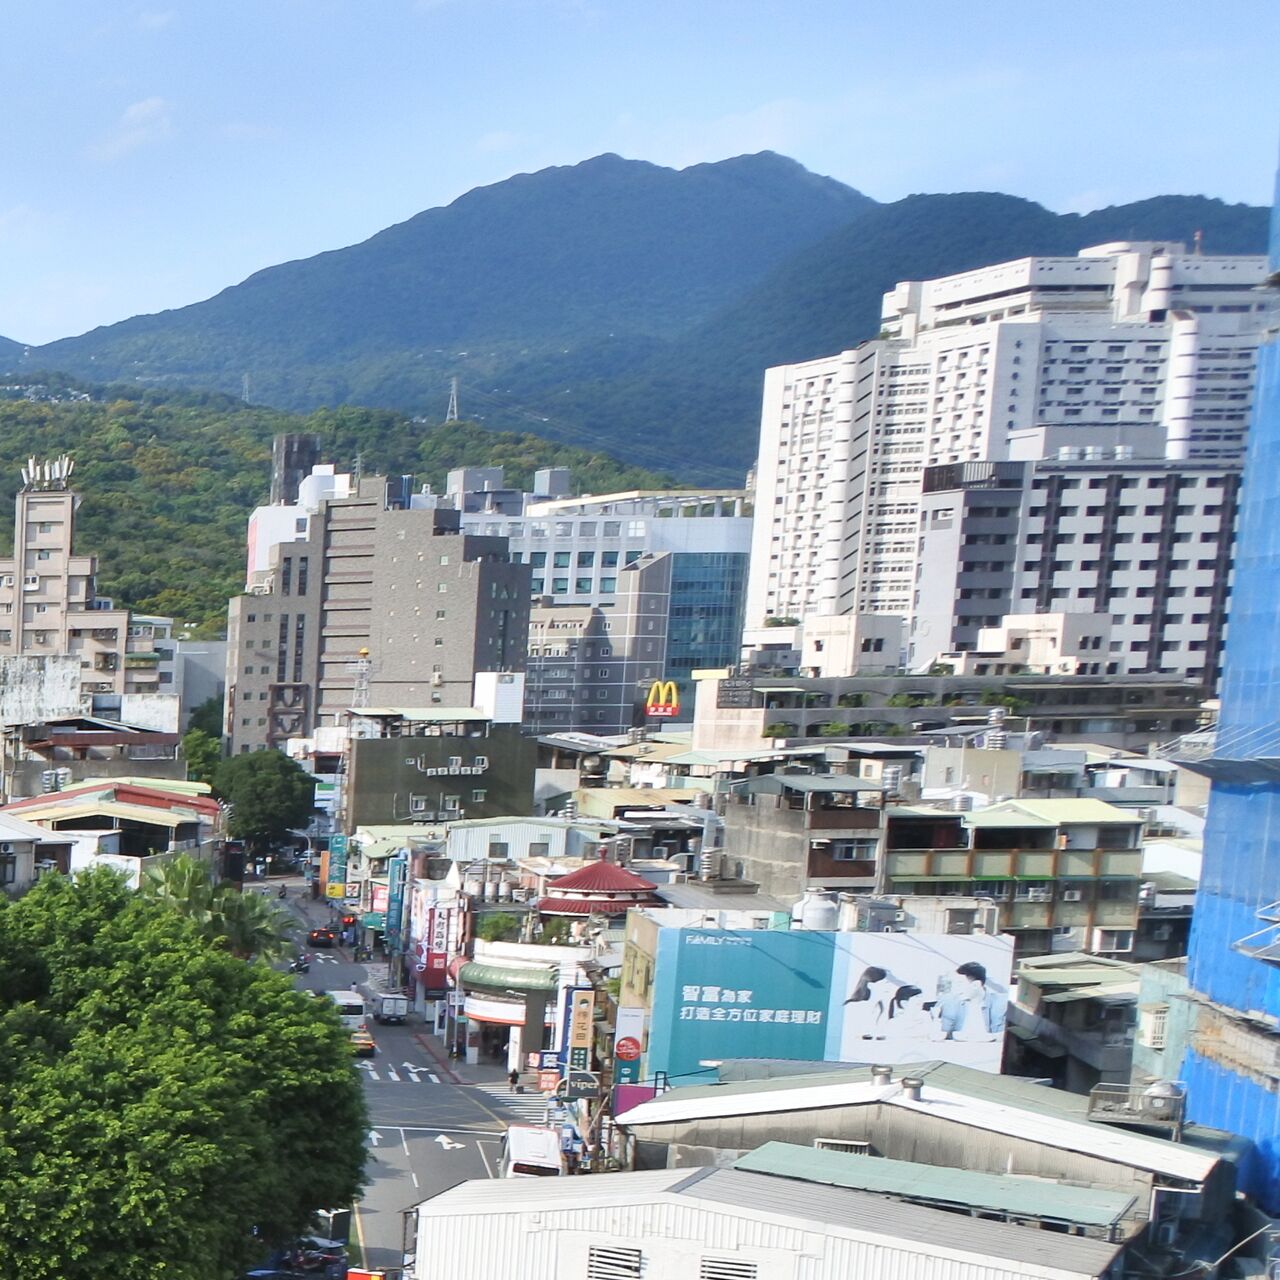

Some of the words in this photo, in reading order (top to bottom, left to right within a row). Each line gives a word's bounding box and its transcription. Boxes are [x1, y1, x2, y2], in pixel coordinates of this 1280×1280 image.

[682, 985, 753, 1003] 智富為家
[679, 1006, 822, 1024] 打造全方位家庭理財
[570, 1078, 599, 1090] viper
